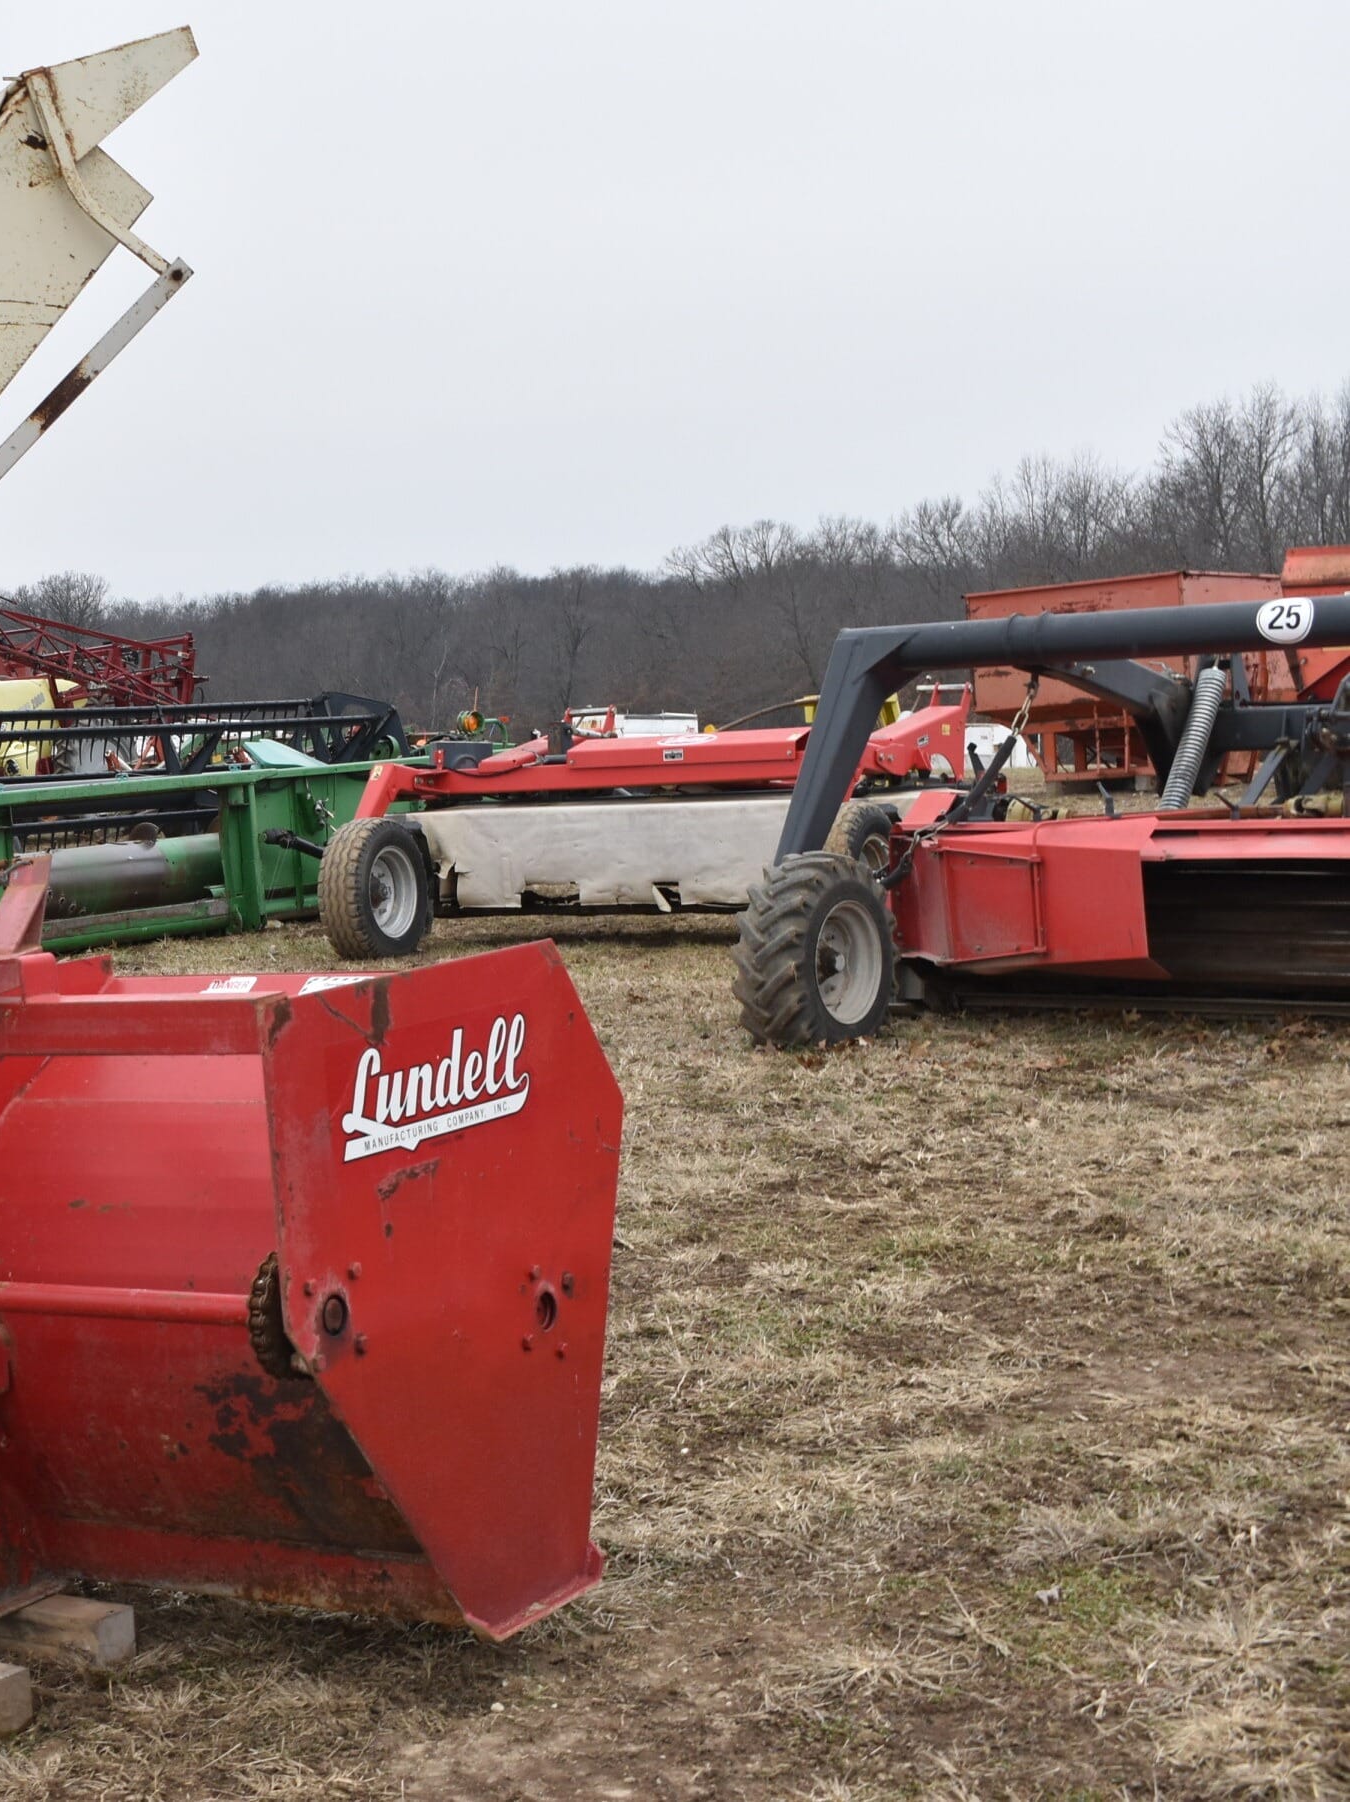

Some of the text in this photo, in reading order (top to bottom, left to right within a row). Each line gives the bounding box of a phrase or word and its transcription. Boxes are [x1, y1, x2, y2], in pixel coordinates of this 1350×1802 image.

[1268, 604, 1302, 630] 25
[342, 1013, 530, 1134] Lundell
[364, 1122, 438, 1151] MANUFACTURING
[494, 1101, 511, 1113] INC.
